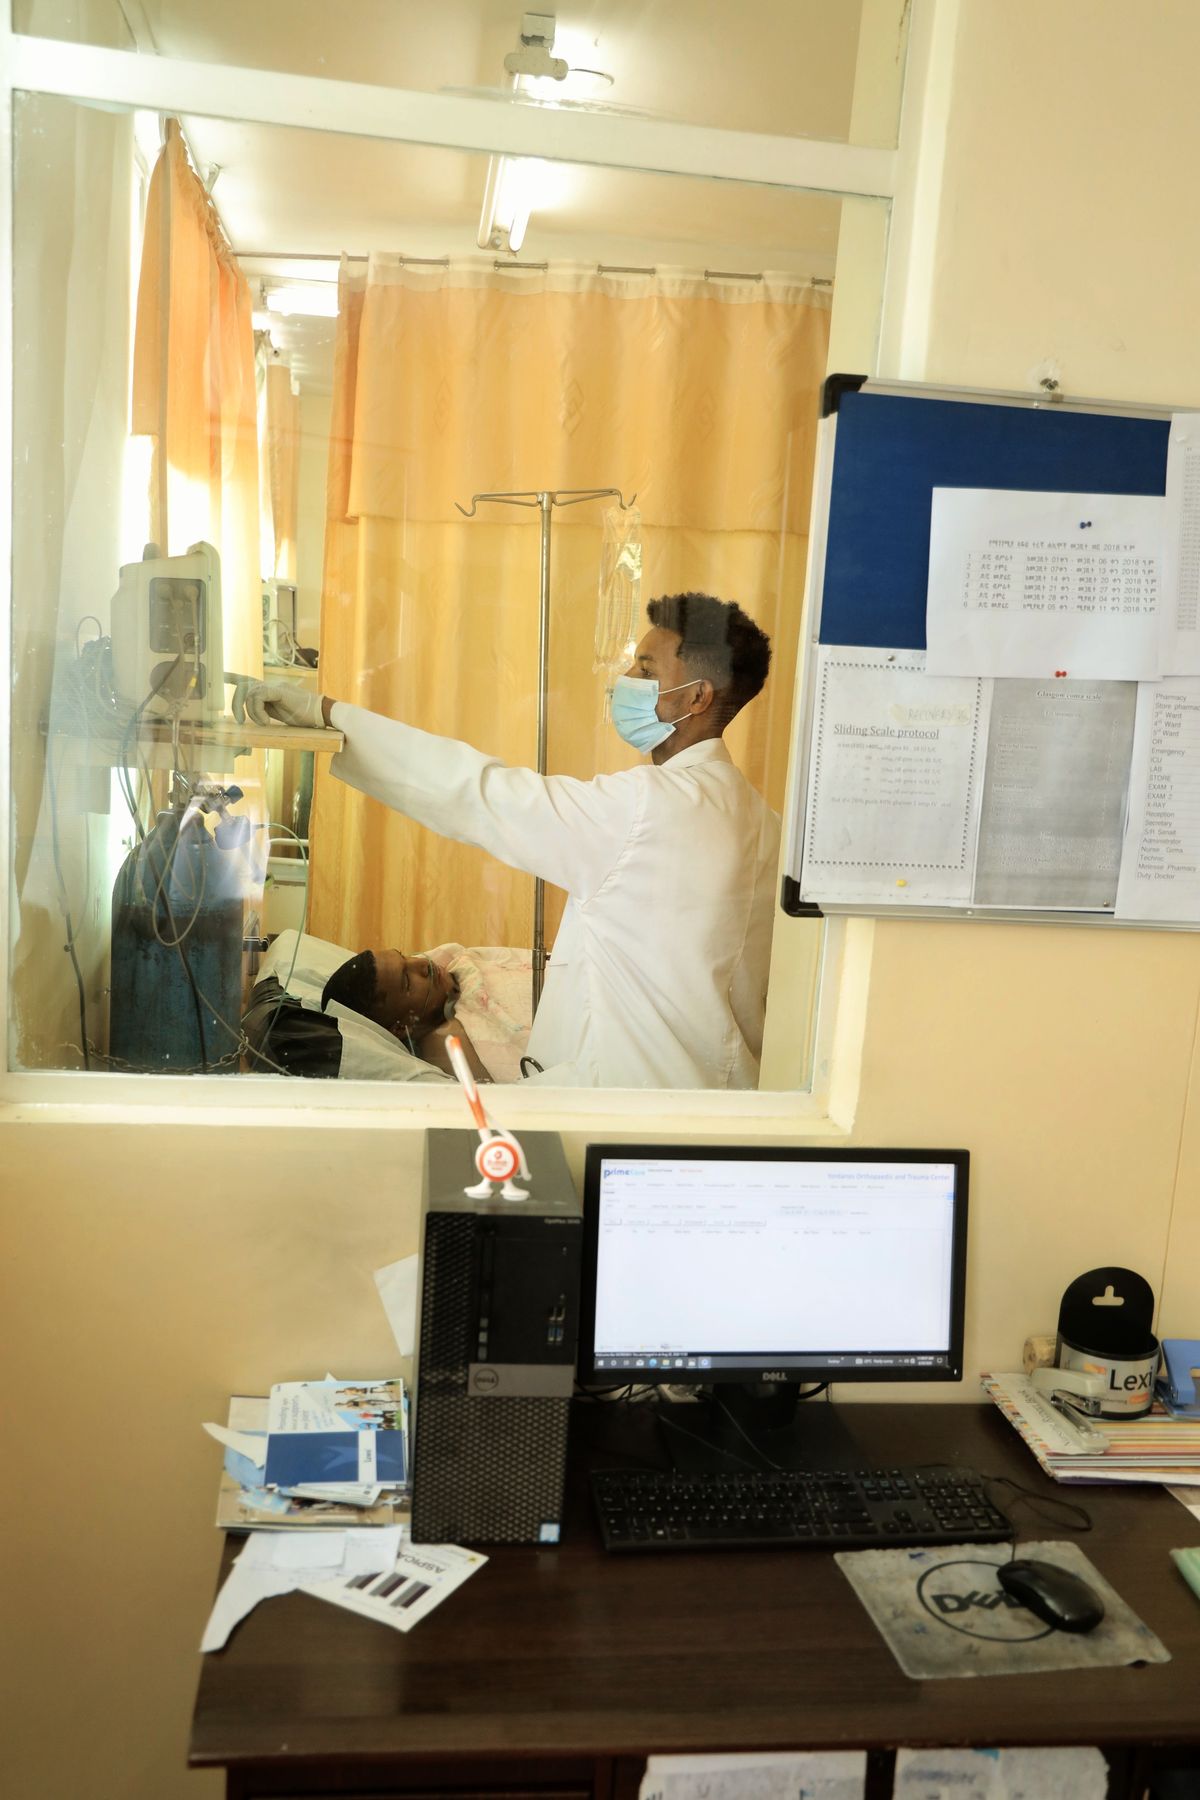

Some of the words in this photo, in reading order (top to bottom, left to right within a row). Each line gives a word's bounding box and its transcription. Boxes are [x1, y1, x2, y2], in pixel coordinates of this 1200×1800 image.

[1122, 558, 1139, 566] 2018
[1125, 577, 1142, 585] 2018
[1123, 587, 1141, 595] 2018
[1123, 596, 1140, 604] 2018
[1122, 605, 1140, 613] 2018
[1155, 693, 1187, 702] Pharmacy
[833, 723, 868, 737] Sliding
[870, 725, 895, 737] Scale
[897, 728, 940, 740] protocol
[1151, 748, 1185, 757] Emergency
[1146, 811, 1175, 819] Reception
[1144, 819, 1172, 828] Secretary
[1137, 872, 1152, 880] Duty
[763, 1371, 788, 1381] DELL
[475, 1376, 497, 1385] DELL
